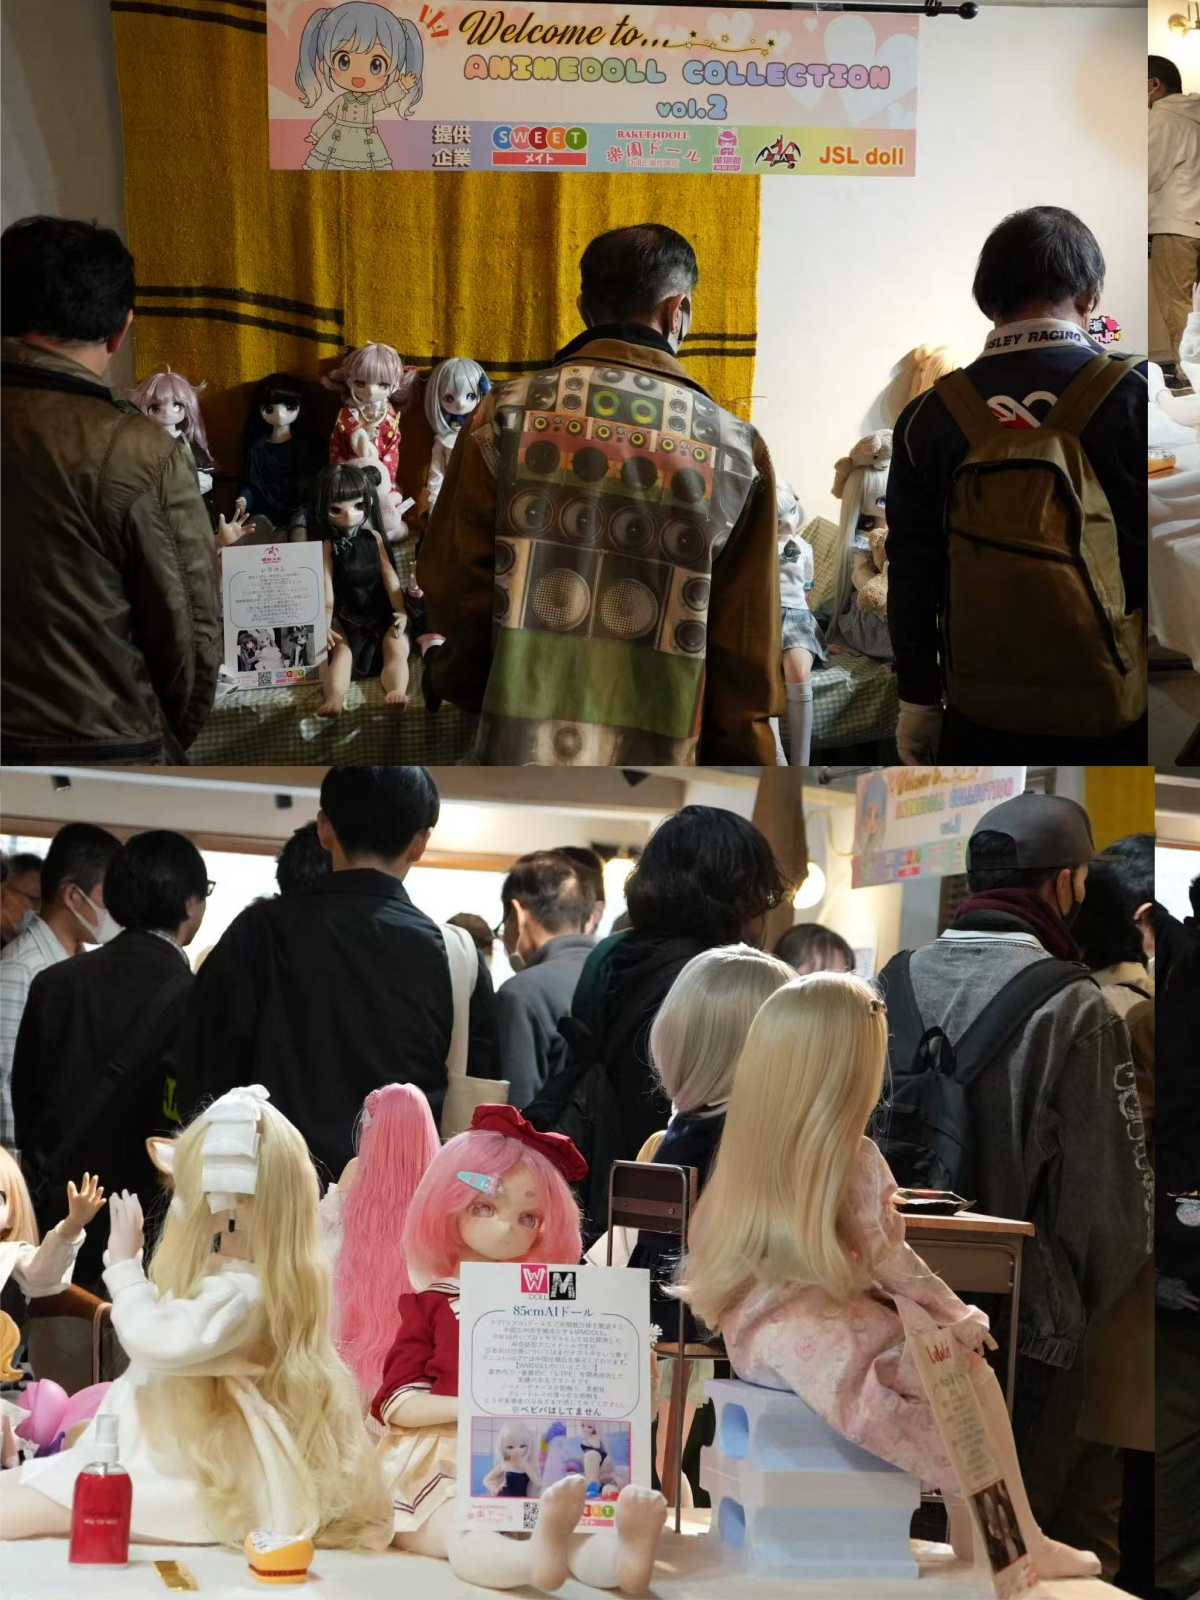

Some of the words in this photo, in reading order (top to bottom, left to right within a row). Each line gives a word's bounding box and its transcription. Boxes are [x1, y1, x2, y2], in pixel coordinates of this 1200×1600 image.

[458, 10, 606, 46] Welcome
[463, 54, 667, 84] ANIMEDOLL
[682, 59, 891, 90] COLLECTION
[655, 93, 728, 120] vol.2
[432, 124, 471, 145] 提供
[496, 129, 584, 147] SWEET
[617, 130, 690, 140] RAKUENDOLL
[432, 148, 471, 168] 企業
[525, 153, 554, 164] メイト
[606, 141, 700, 163] 楽園ドール
[819, 146, 859, 165] JSL
[865, 147, 904, 166] doll
[1028, 330, 1081, 343] RACING
[1092, 329, 1115, 343] m.jp
[513, 1305, 594, 1318] 85cmAIドール
[583, 1505, 613, 1517] EET
